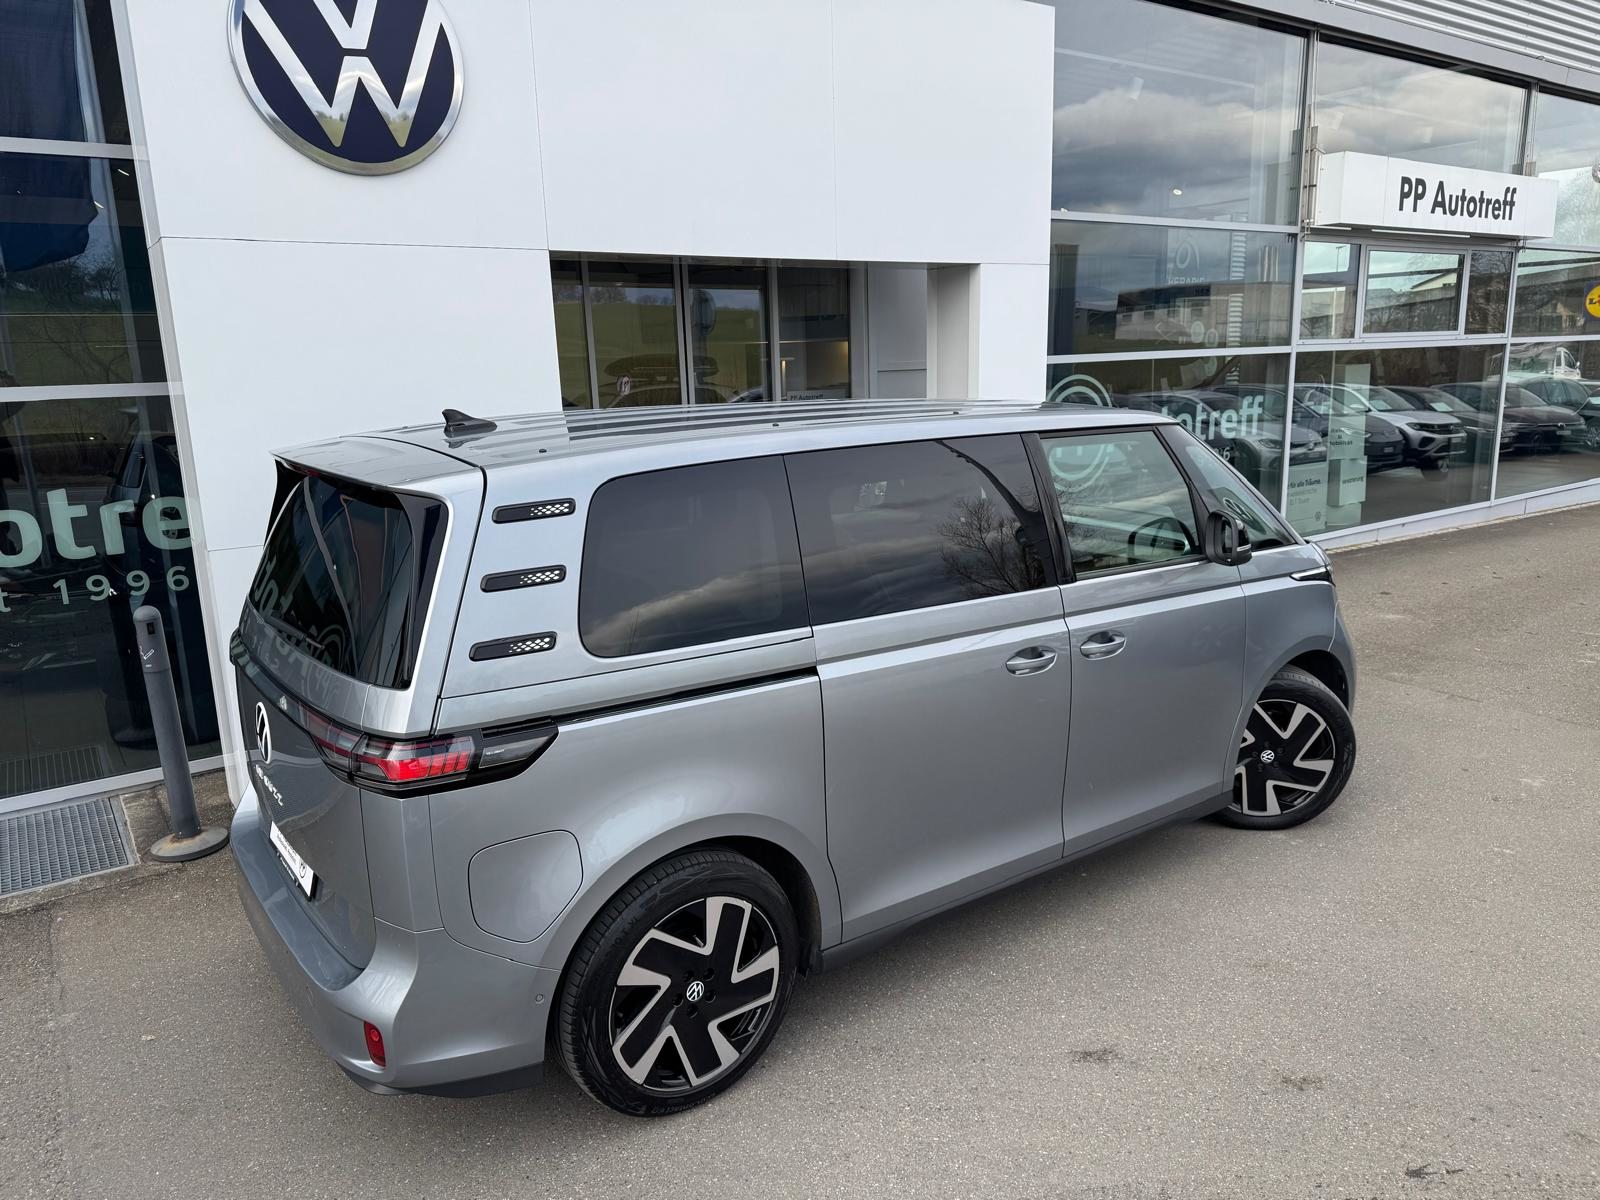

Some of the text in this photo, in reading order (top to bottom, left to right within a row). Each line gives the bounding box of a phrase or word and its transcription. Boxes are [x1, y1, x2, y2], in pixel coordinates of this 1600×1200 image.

[1398, 176, 1517, 220] PP Autotreff
[53, 566, 190, 604] 1996
